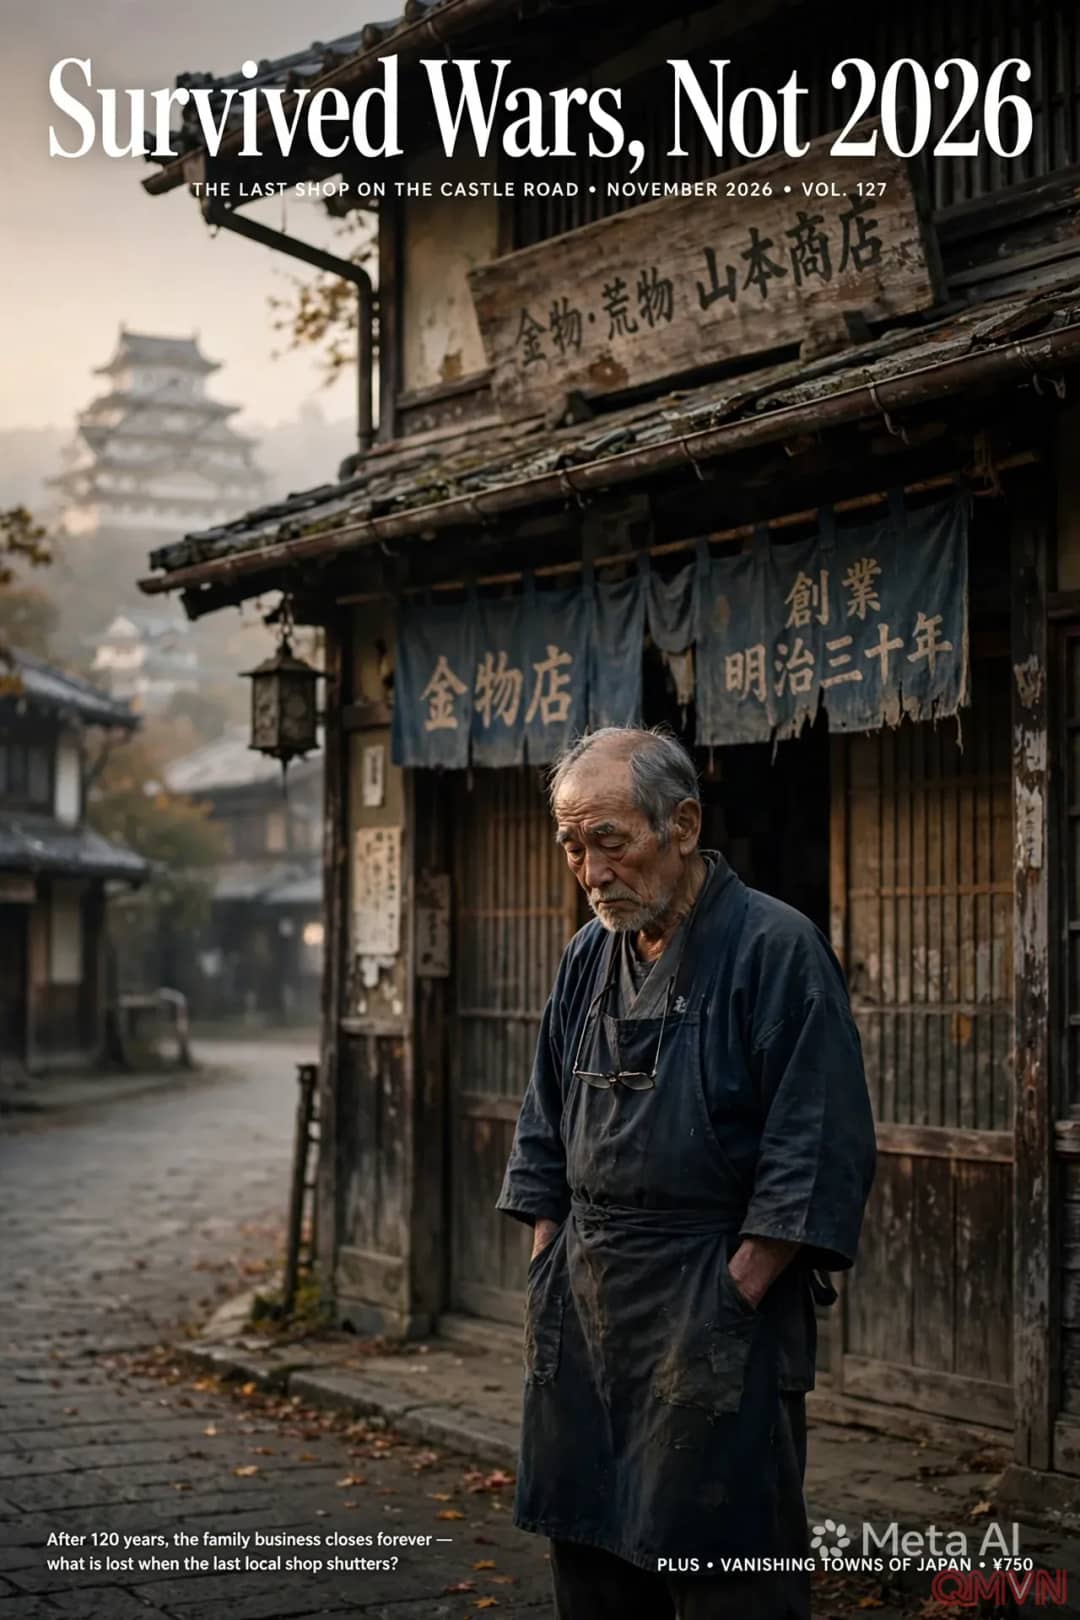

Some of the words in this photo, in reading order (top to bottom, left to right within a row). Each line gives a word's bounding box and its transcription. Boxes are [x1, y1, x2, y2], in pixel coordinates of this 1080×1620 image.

[698, 195, 883, 310] 山本商店
[785, 558, 882, 630] 創業
[420, 645, 573, 731] 金物店
[725, 611, 952, 702] 明治三十年
